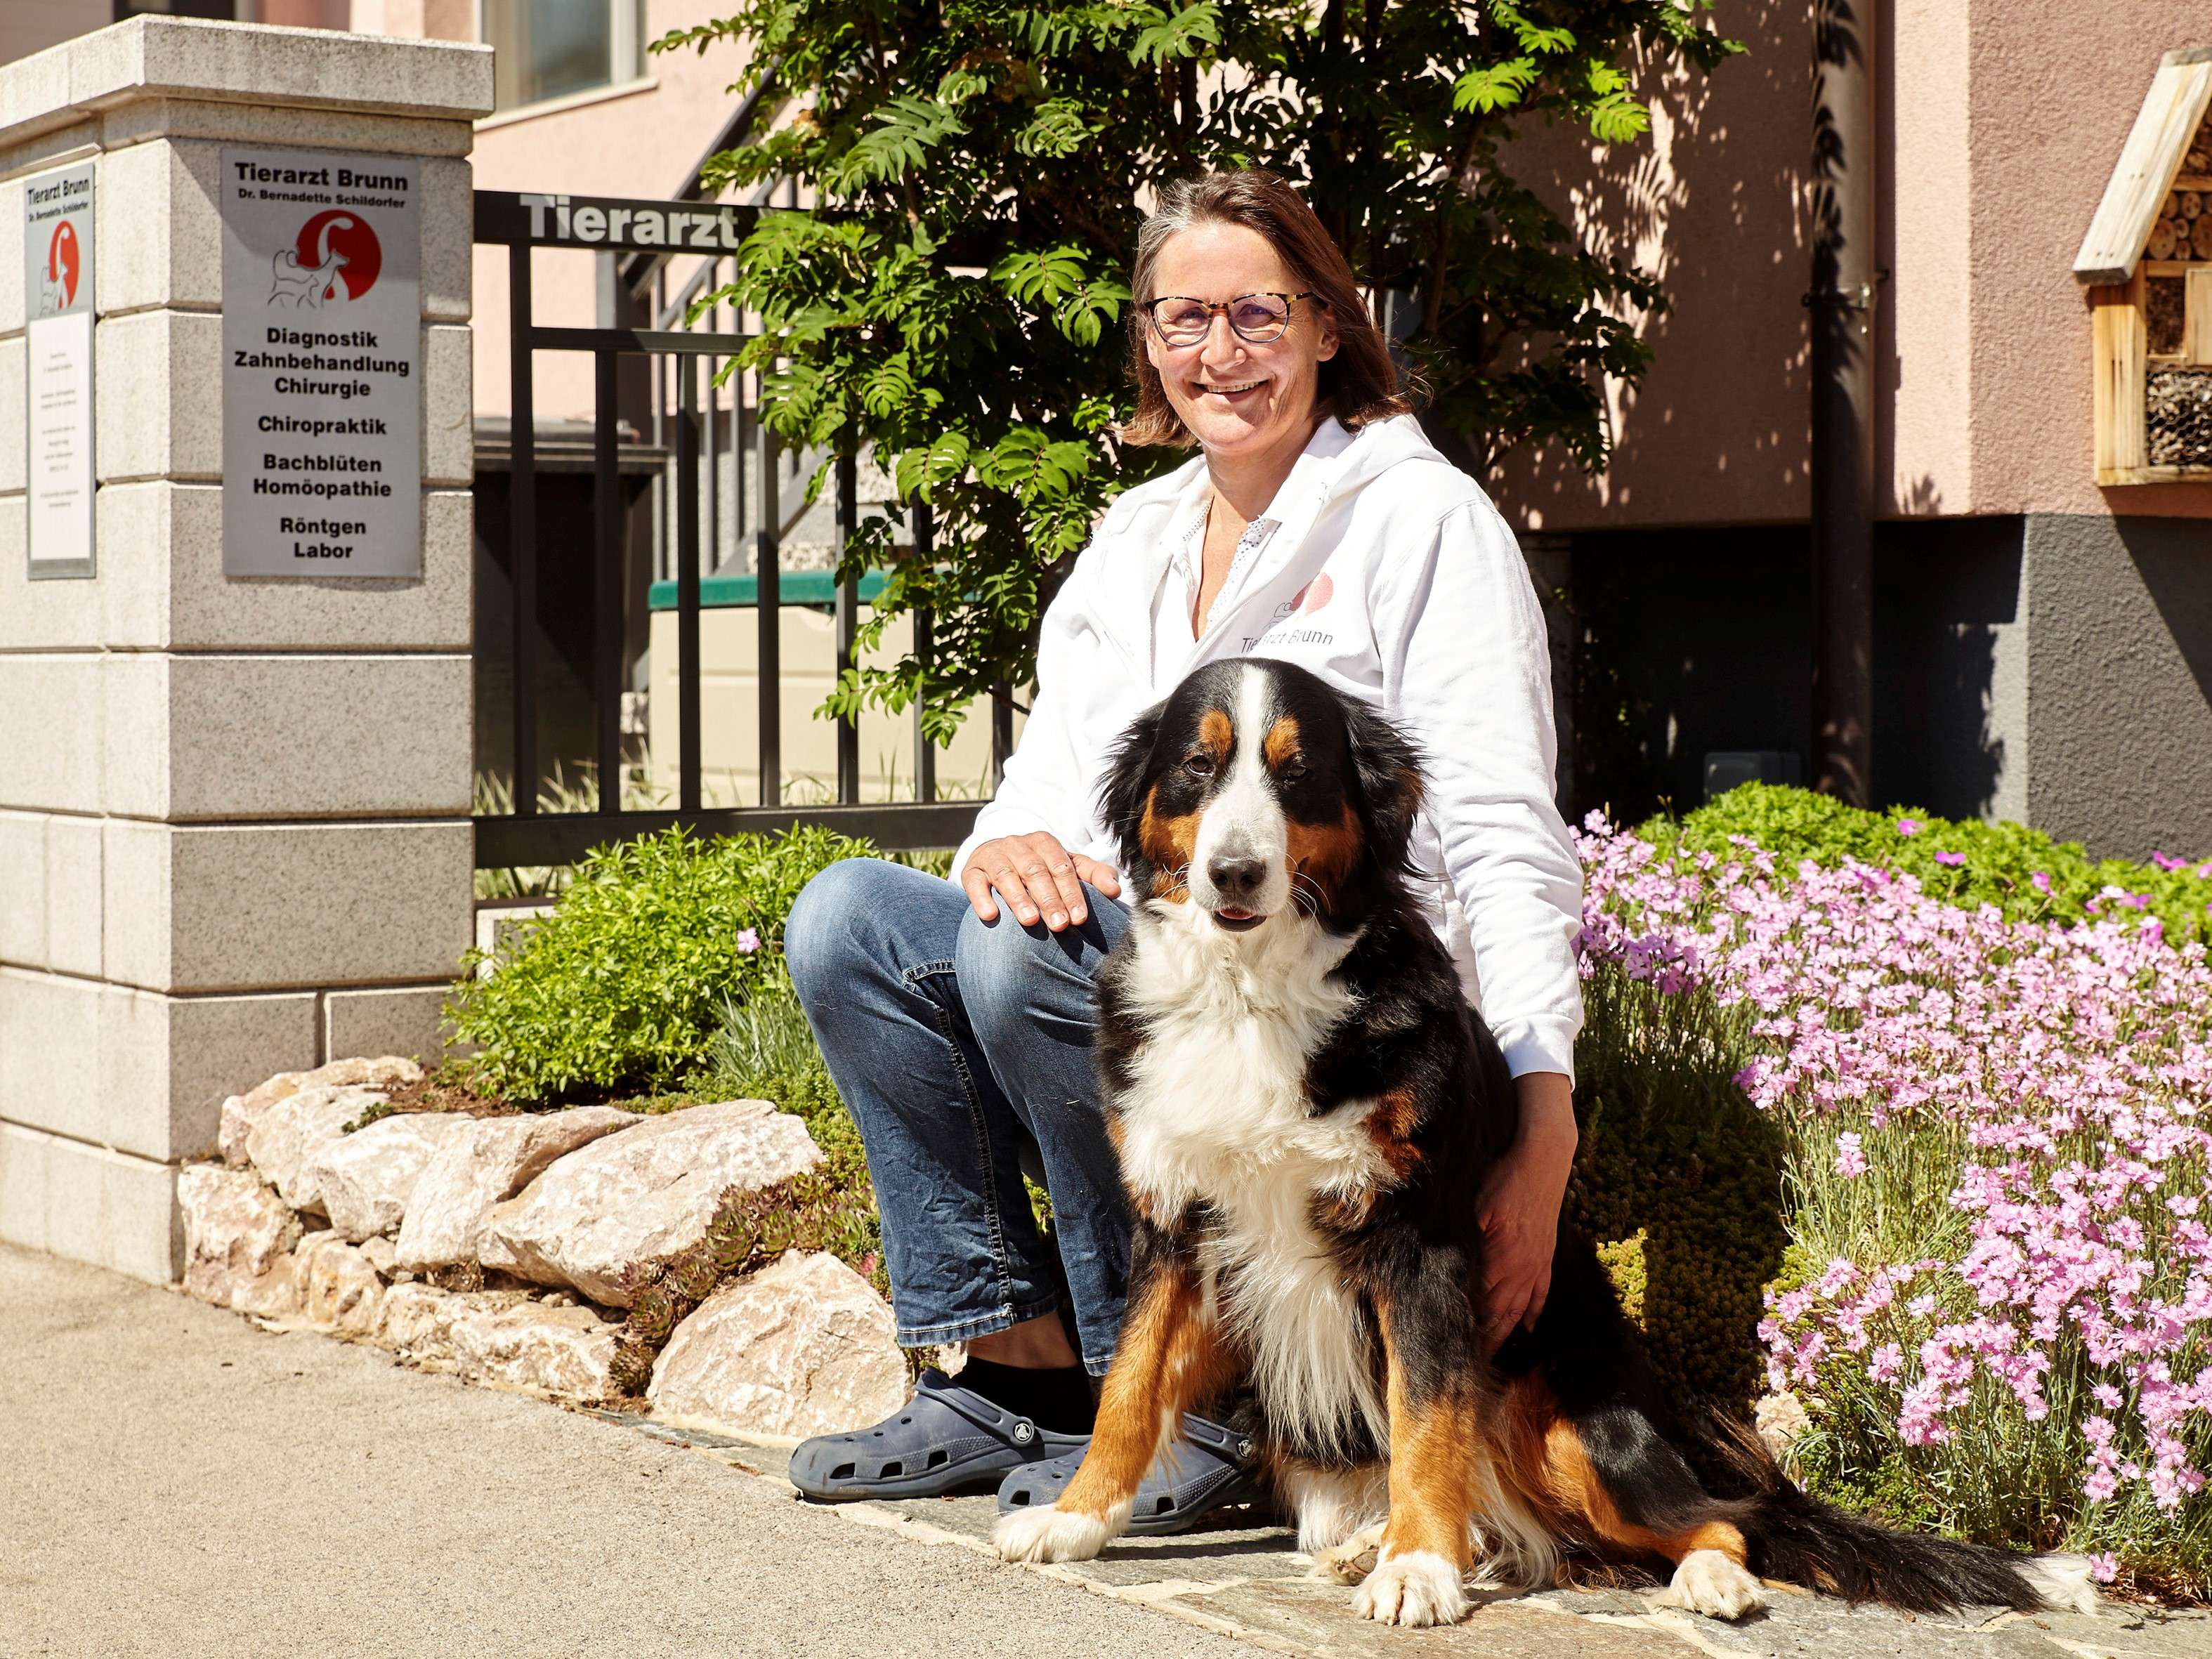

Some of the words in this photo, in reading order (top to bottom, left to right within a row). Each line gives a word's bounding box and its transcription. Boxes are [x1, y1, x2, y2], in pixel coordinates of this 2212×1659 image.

[235, 162, 329, 188] Tierarzt
[337, 169, 408, 191] Brunn
[27, 181, 60, 205] Tierarzt
[63, 179, 89, 196] Brunn
[238, 188, 256, 199] Dr.
[260, 189, 332, 204] Bernadette
[336, 194, 405, 211] Schildorfer
[520, 194, 738, 249] Tierarzt
[267, 327, 378, 348] Diagnostik
[235, 350, 410, 377] Zahnbehandlung
[275, 376, 371, 399] Chirurgie
[258, 416, 386, 436] Chiropraktik
[263, 454, 381, 473] Bachblüten
[254, 478, 391, 499] Homöopathie
[280, 517, 366, 538] Röntgen
[294, 542, 353, 558] Labor
[1288, 629, 1333, 645] Brunn
